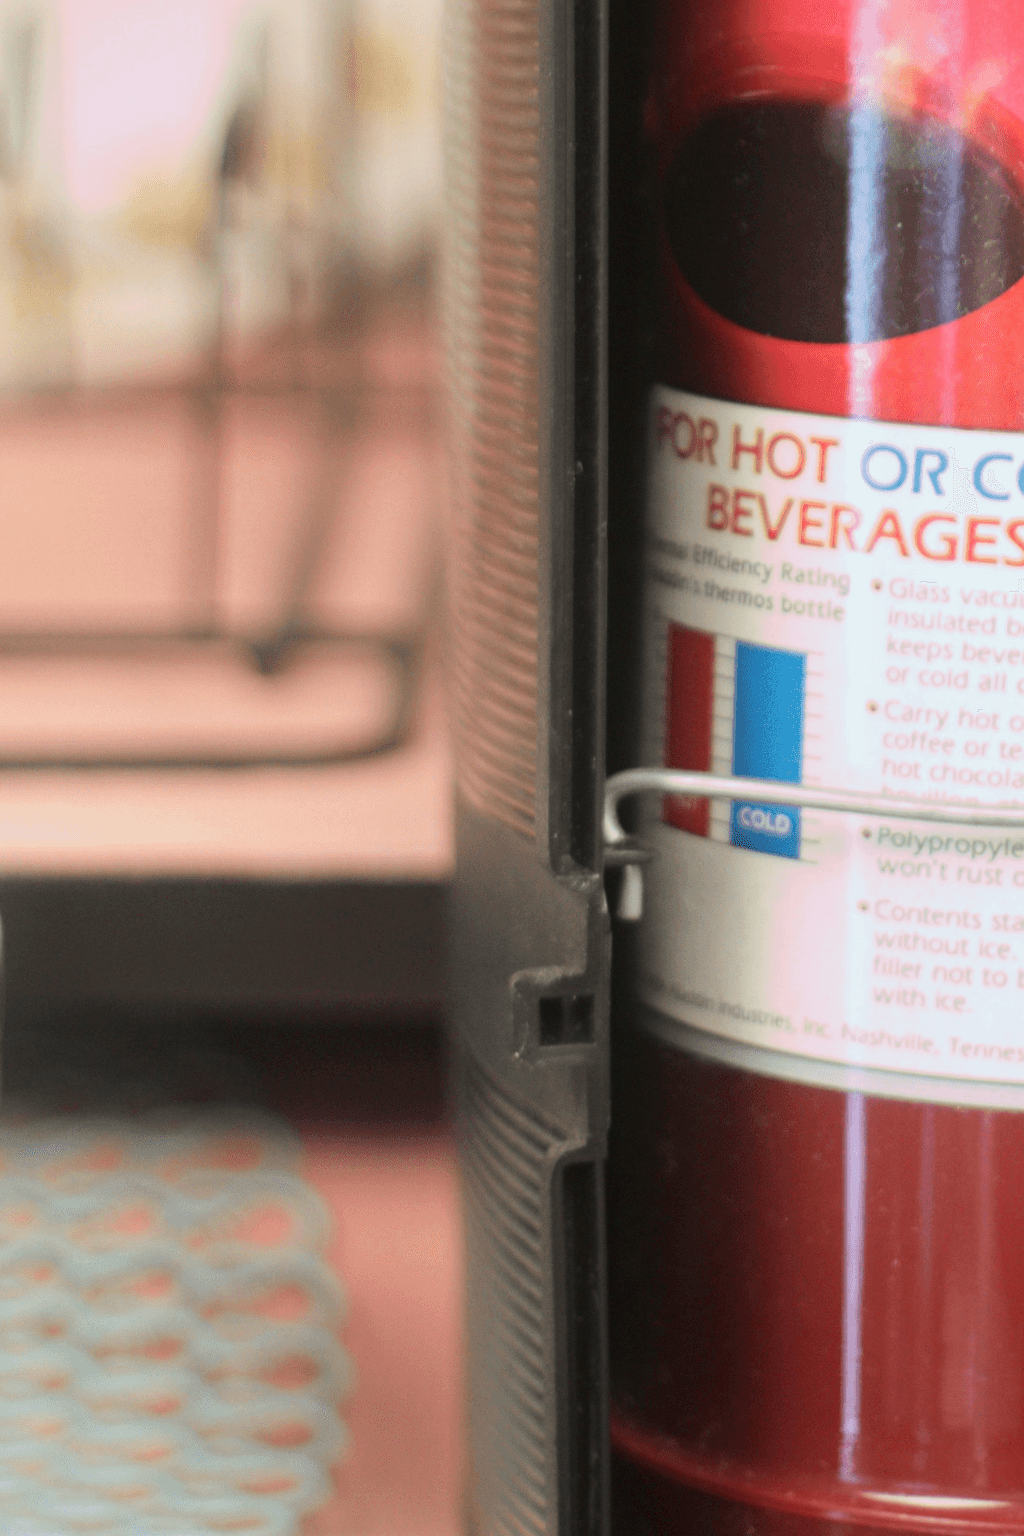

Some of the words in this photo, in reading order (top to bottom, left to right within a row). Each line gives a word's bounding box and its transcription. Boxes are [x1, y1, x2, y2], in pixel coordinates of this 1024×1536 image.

[657, 407, 719, 466] FOR
[731, 424, 840, 484] HOT
[860, 442, 950, 497] OR
[693, 544, 774, 584] Efficiency
[780, 561, 851, 596] Rating
[703, 580, 775, 612] thermos
[780, 594, 846, 622] bottle
[888, 577, 952, 605] Glass
[887, 606, 998, 636] insulated
[886, 634, 954, 663] keeps
[885, 666, 910, 684] or
[918, 669, 969, 690] cold
[978, 673, 1008, 693] all
[883, 699, 949, 732] Carry
[957, 708, 1001, 732] hot
[882, 730, 956, 755] coffee
[963, 739, 991, 758] or
[881, 757, 921, 780] hot
[739, 806, 791, 836] COLD
[876, 857, 948, 882] won't
[956, 866, 1004, 887] rust
[874, 898, 982, 931] Contents
[874, 930, 969, 958] without
[978, 938, 1019, 961] ice.
[873, 954, 922, 979] filler
[932, 964, 974, 986] not
[982, 967, 1008, 989] to
[873, 986, 926, 1006] with
[934, 991, 973, 1014] ice.
[841, 1022, 941, 1056] Nashville,
